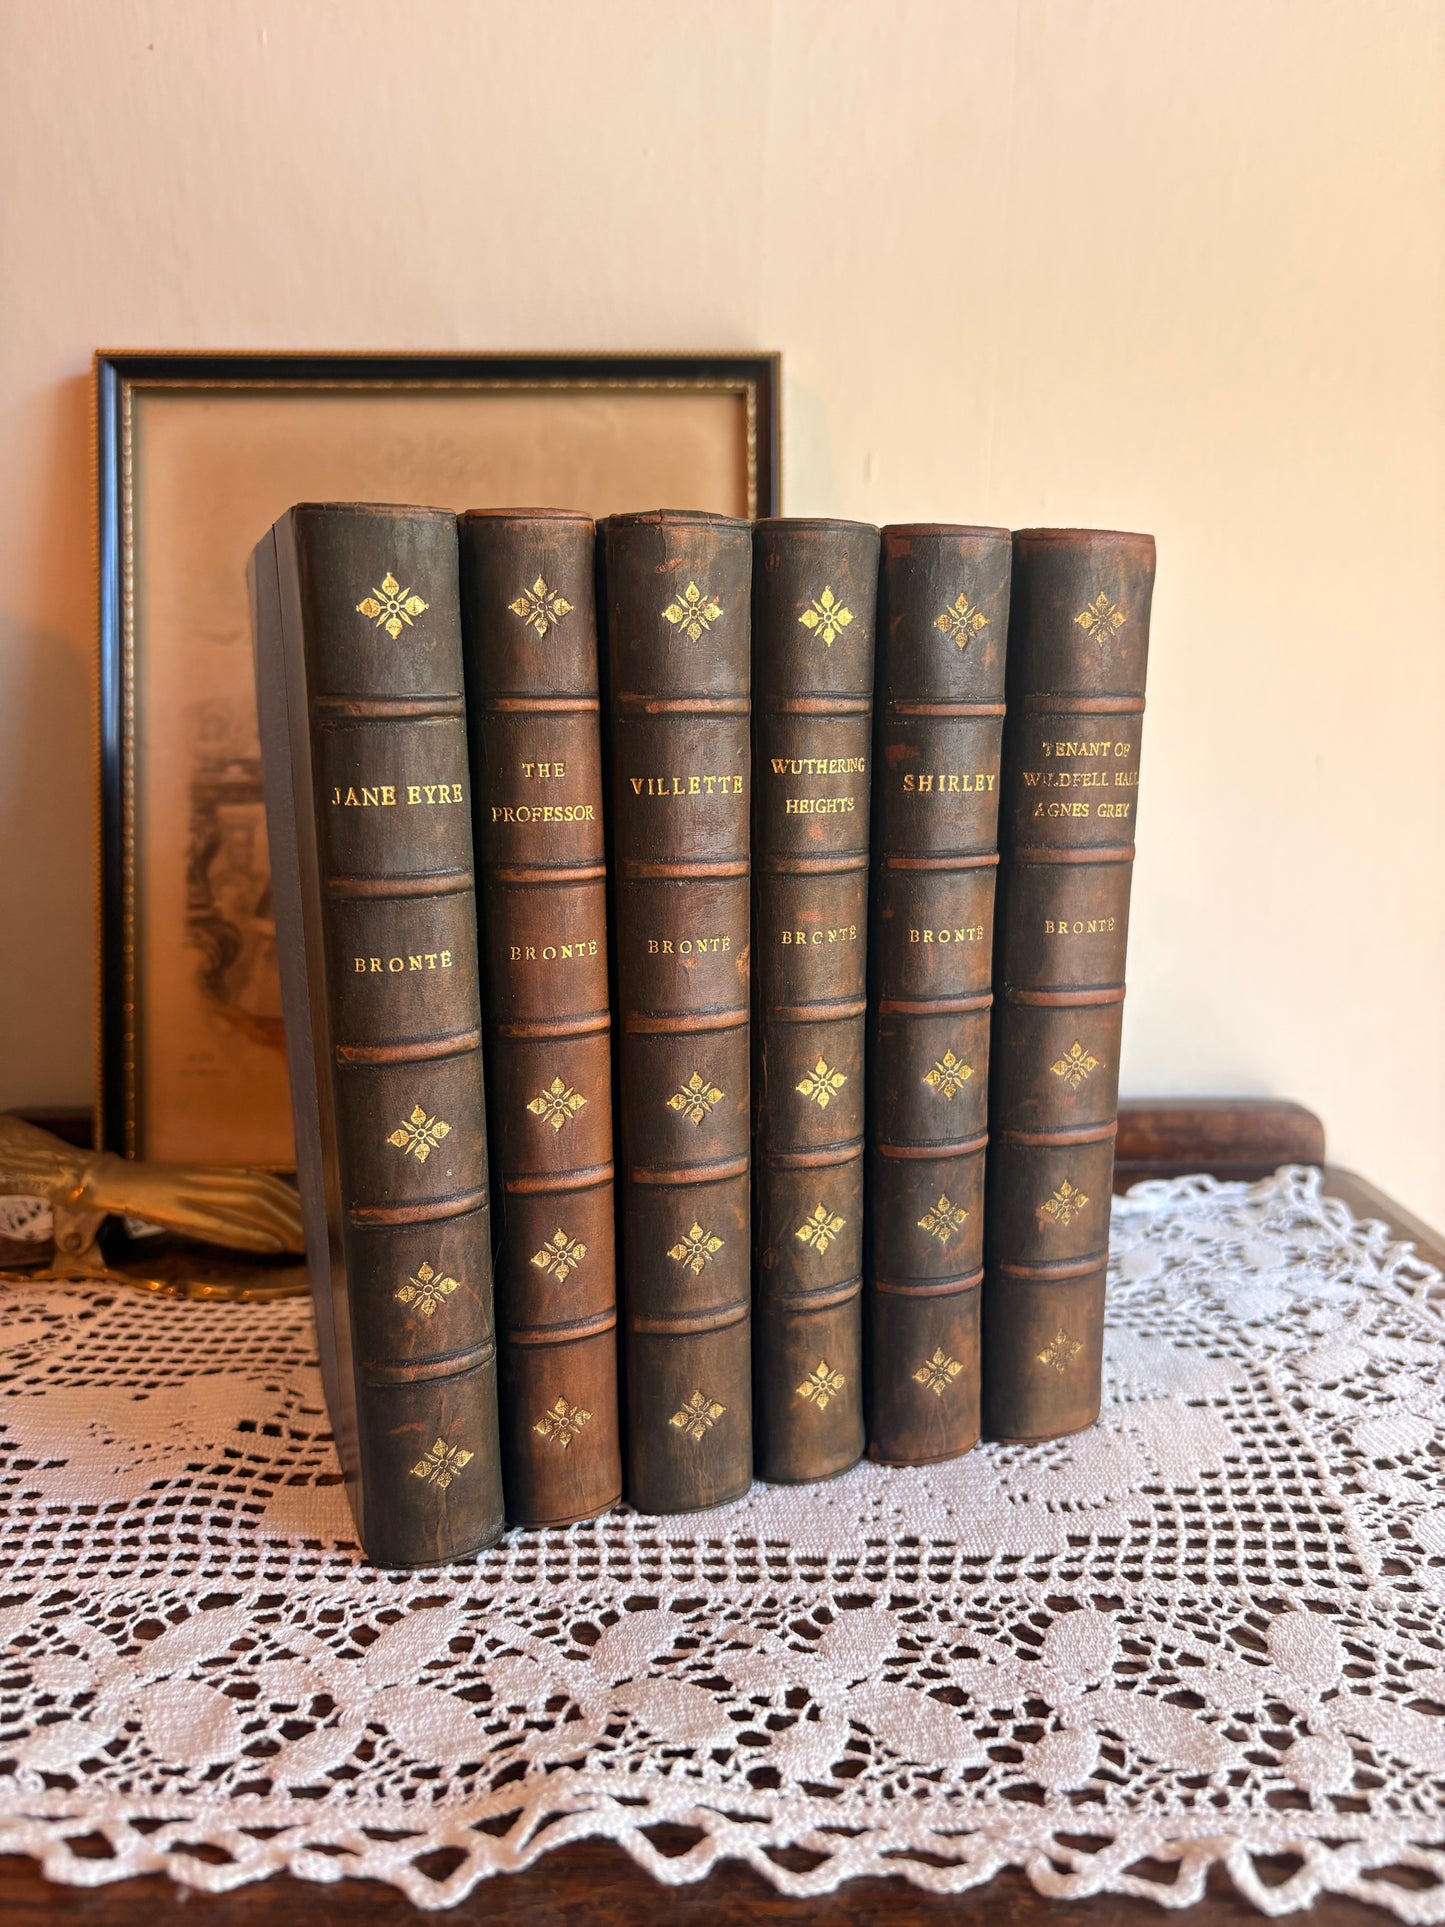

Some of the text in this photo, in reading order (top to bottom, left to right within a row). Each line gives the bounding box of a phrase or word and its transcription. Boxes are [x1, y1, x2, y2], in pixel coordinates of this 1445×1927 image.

[1042, 742, 1131, 758] TENANT OF
[522, 763, 566, 778] THE
[770, 757, 866, 775] WUTHERING
[629, 775, 744, 796] VILLETTE
[903, 774, 995, 793] SHIRLEY
[331, 783, 463, 807] JANE EYRE
[491, 805, 595, 823] PROFESSOR
[785, 797, 855, 815] HEIGHTS
[1034, 802, 1130, 818] AGNES GREY
[510, 939, 598, 961] BRONTË
[648, 936, 731, 954] BRONTË
[354, 950, 452, 973] BRONTË
